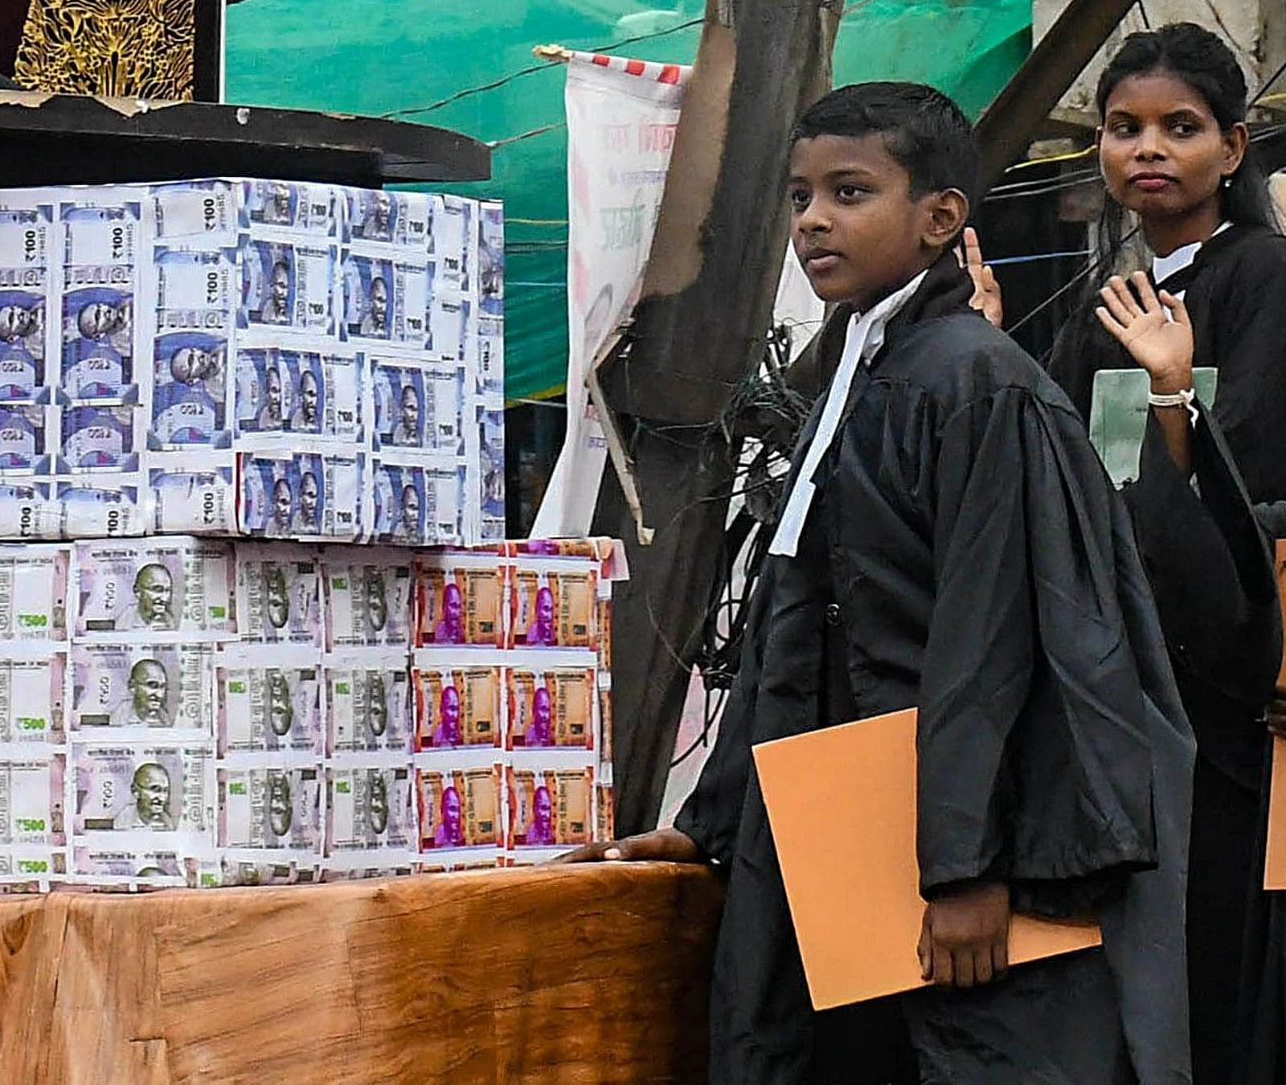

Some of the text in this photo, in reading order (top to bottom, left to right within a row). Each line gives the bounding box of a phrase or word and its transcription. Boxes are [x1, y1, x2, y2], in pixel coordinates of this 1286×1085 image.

[24, 230, 36, 263] ₹100
[112, 227, 124, 260] ₹100
[108, 510, 119, 537] 100
